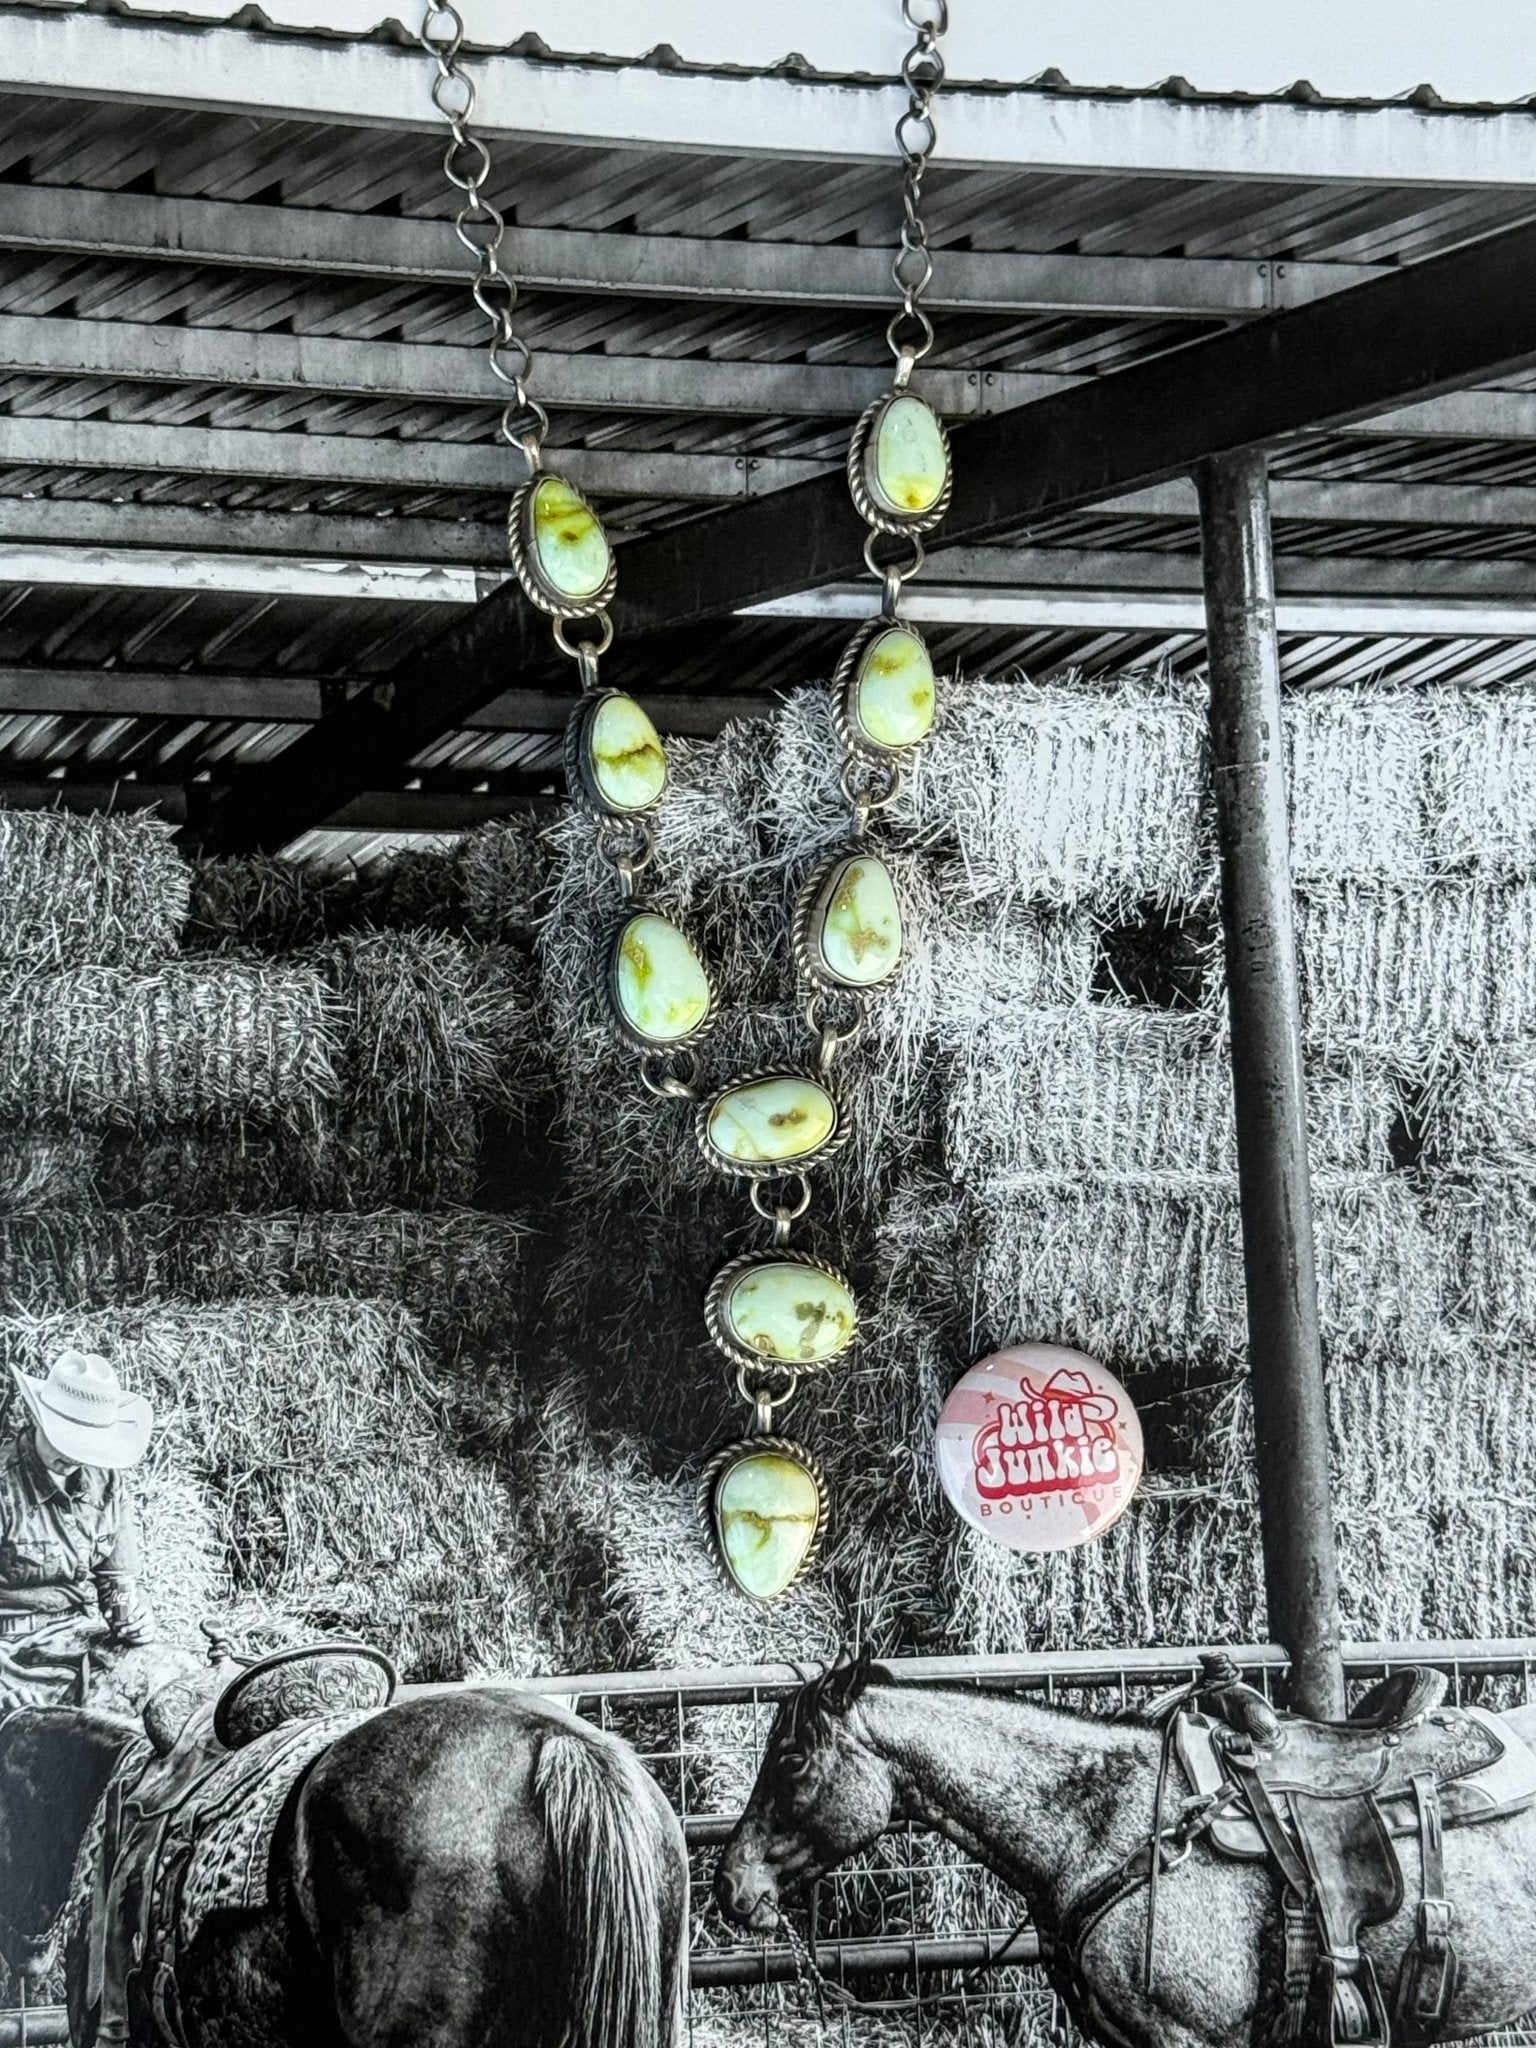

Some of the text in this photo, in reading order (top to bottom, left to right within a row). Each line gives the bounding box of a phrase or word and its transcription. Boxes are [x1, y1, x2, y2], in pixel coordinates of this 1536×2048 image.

[999, 1400, 1086, 1446] Wild
[977, 1435, 1118, 1488] Junkie
[980, 1486, 1123, 1517] BOUTIQUE
